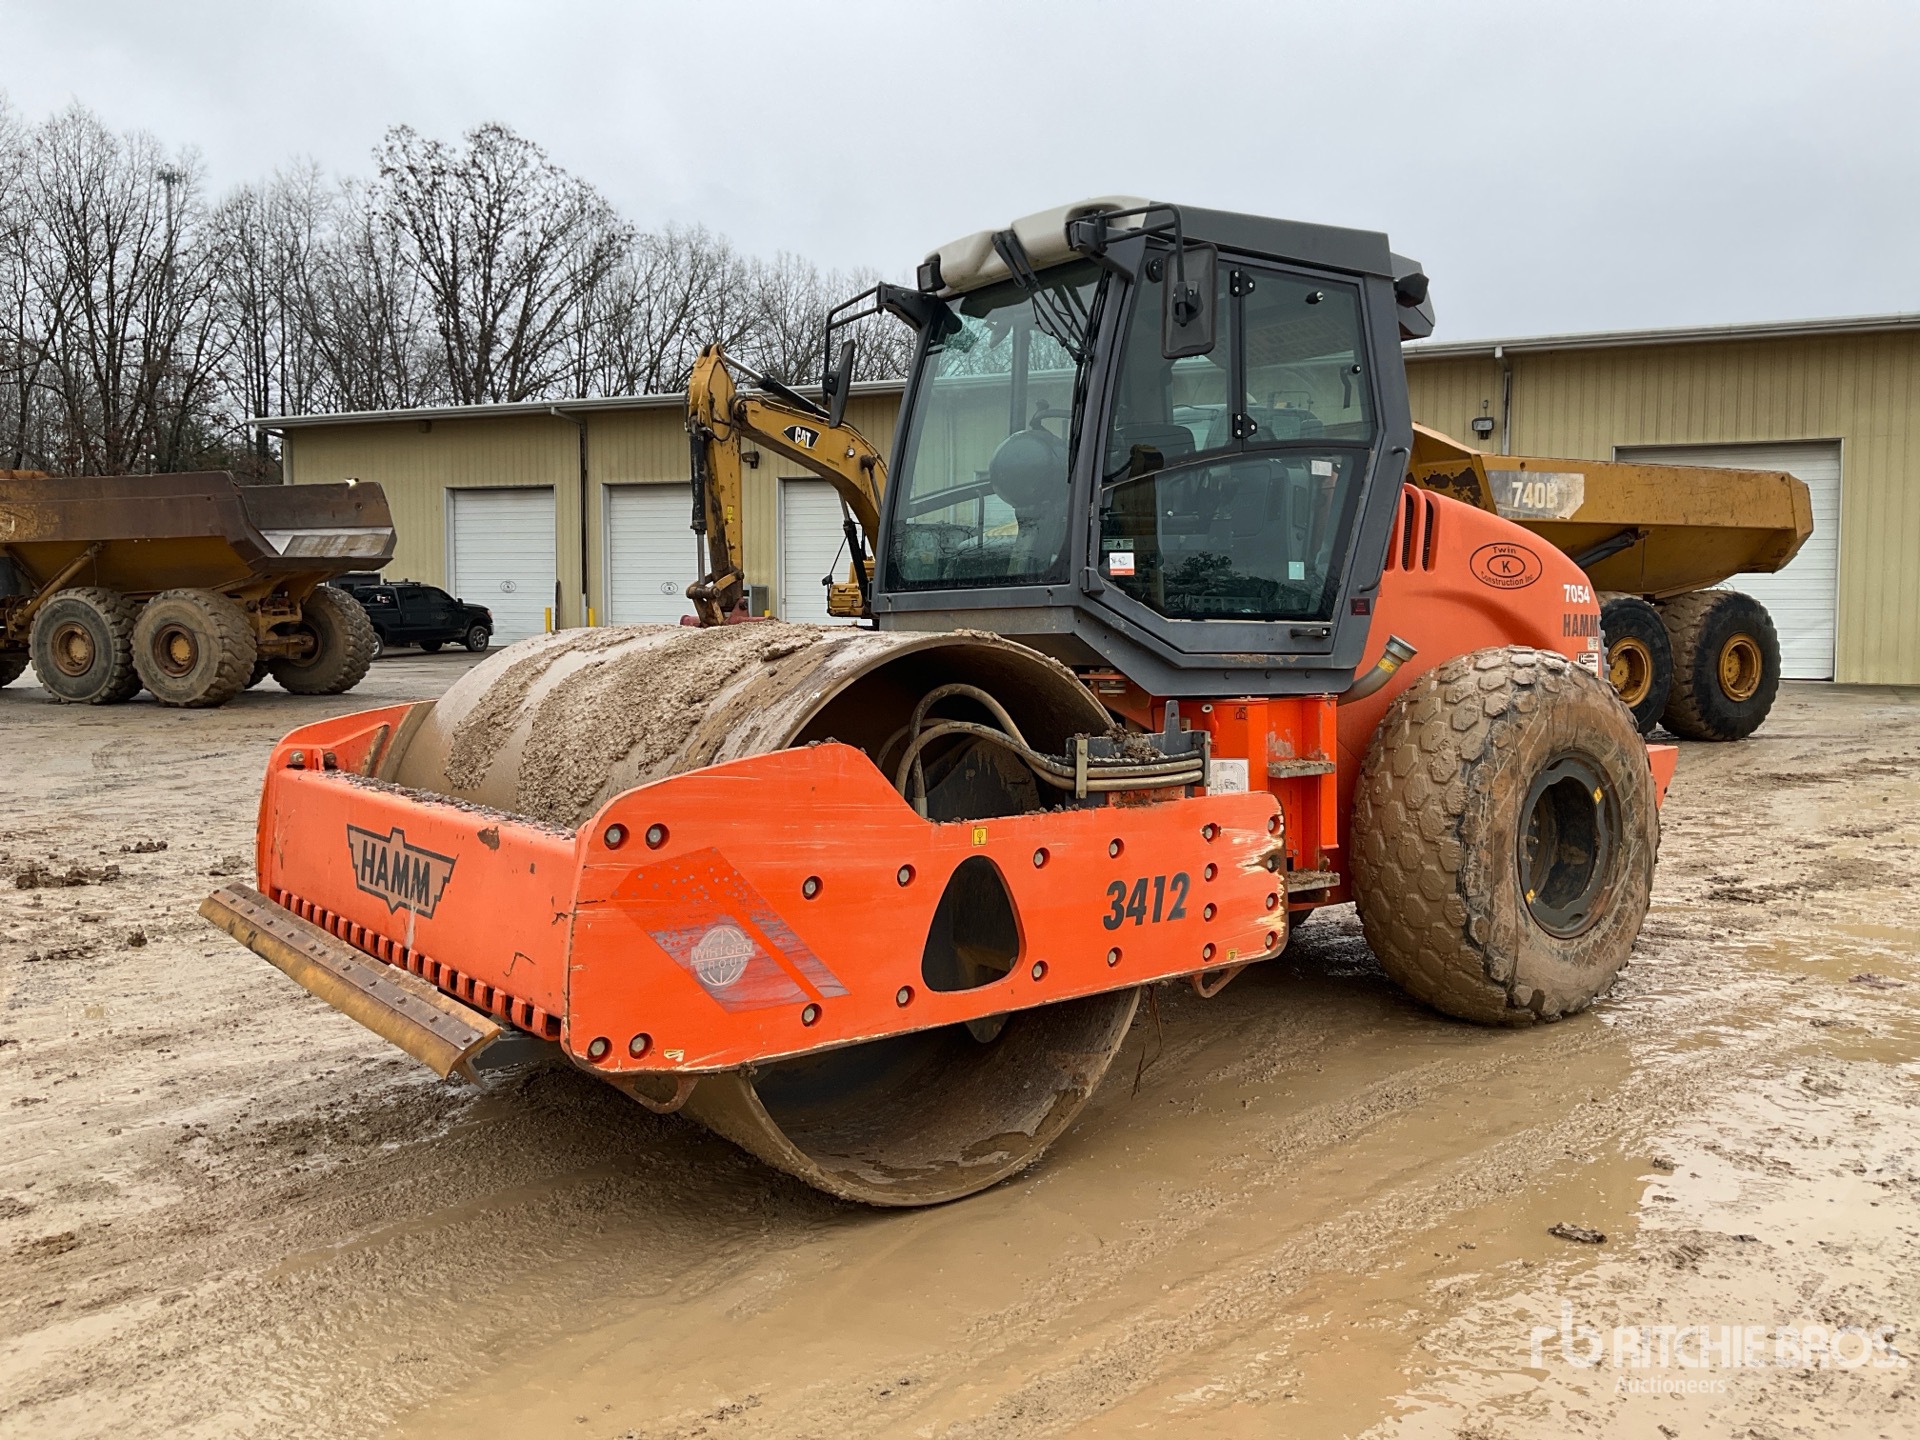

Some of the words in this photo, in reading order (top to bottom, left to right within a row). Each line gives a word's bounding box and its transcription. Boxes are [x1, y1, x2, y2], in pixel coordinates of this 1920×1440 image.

[795, 426, 812, 449] CAT
[1511, 481, 1559, 509] 740B
[1492, 545, 1517, 555] Twin
[1501, 560, 1512, 574] K
[1480, 570, 1524, 587] Construction
[1563, 584, 1591, 604] 7054
[1562, 613, 1599, 637] HAMM
[361, 839, 431, 908] HAMM
[1103, 872, 1191, 931] 3412
[696, 956, 748, 971] GROUP
